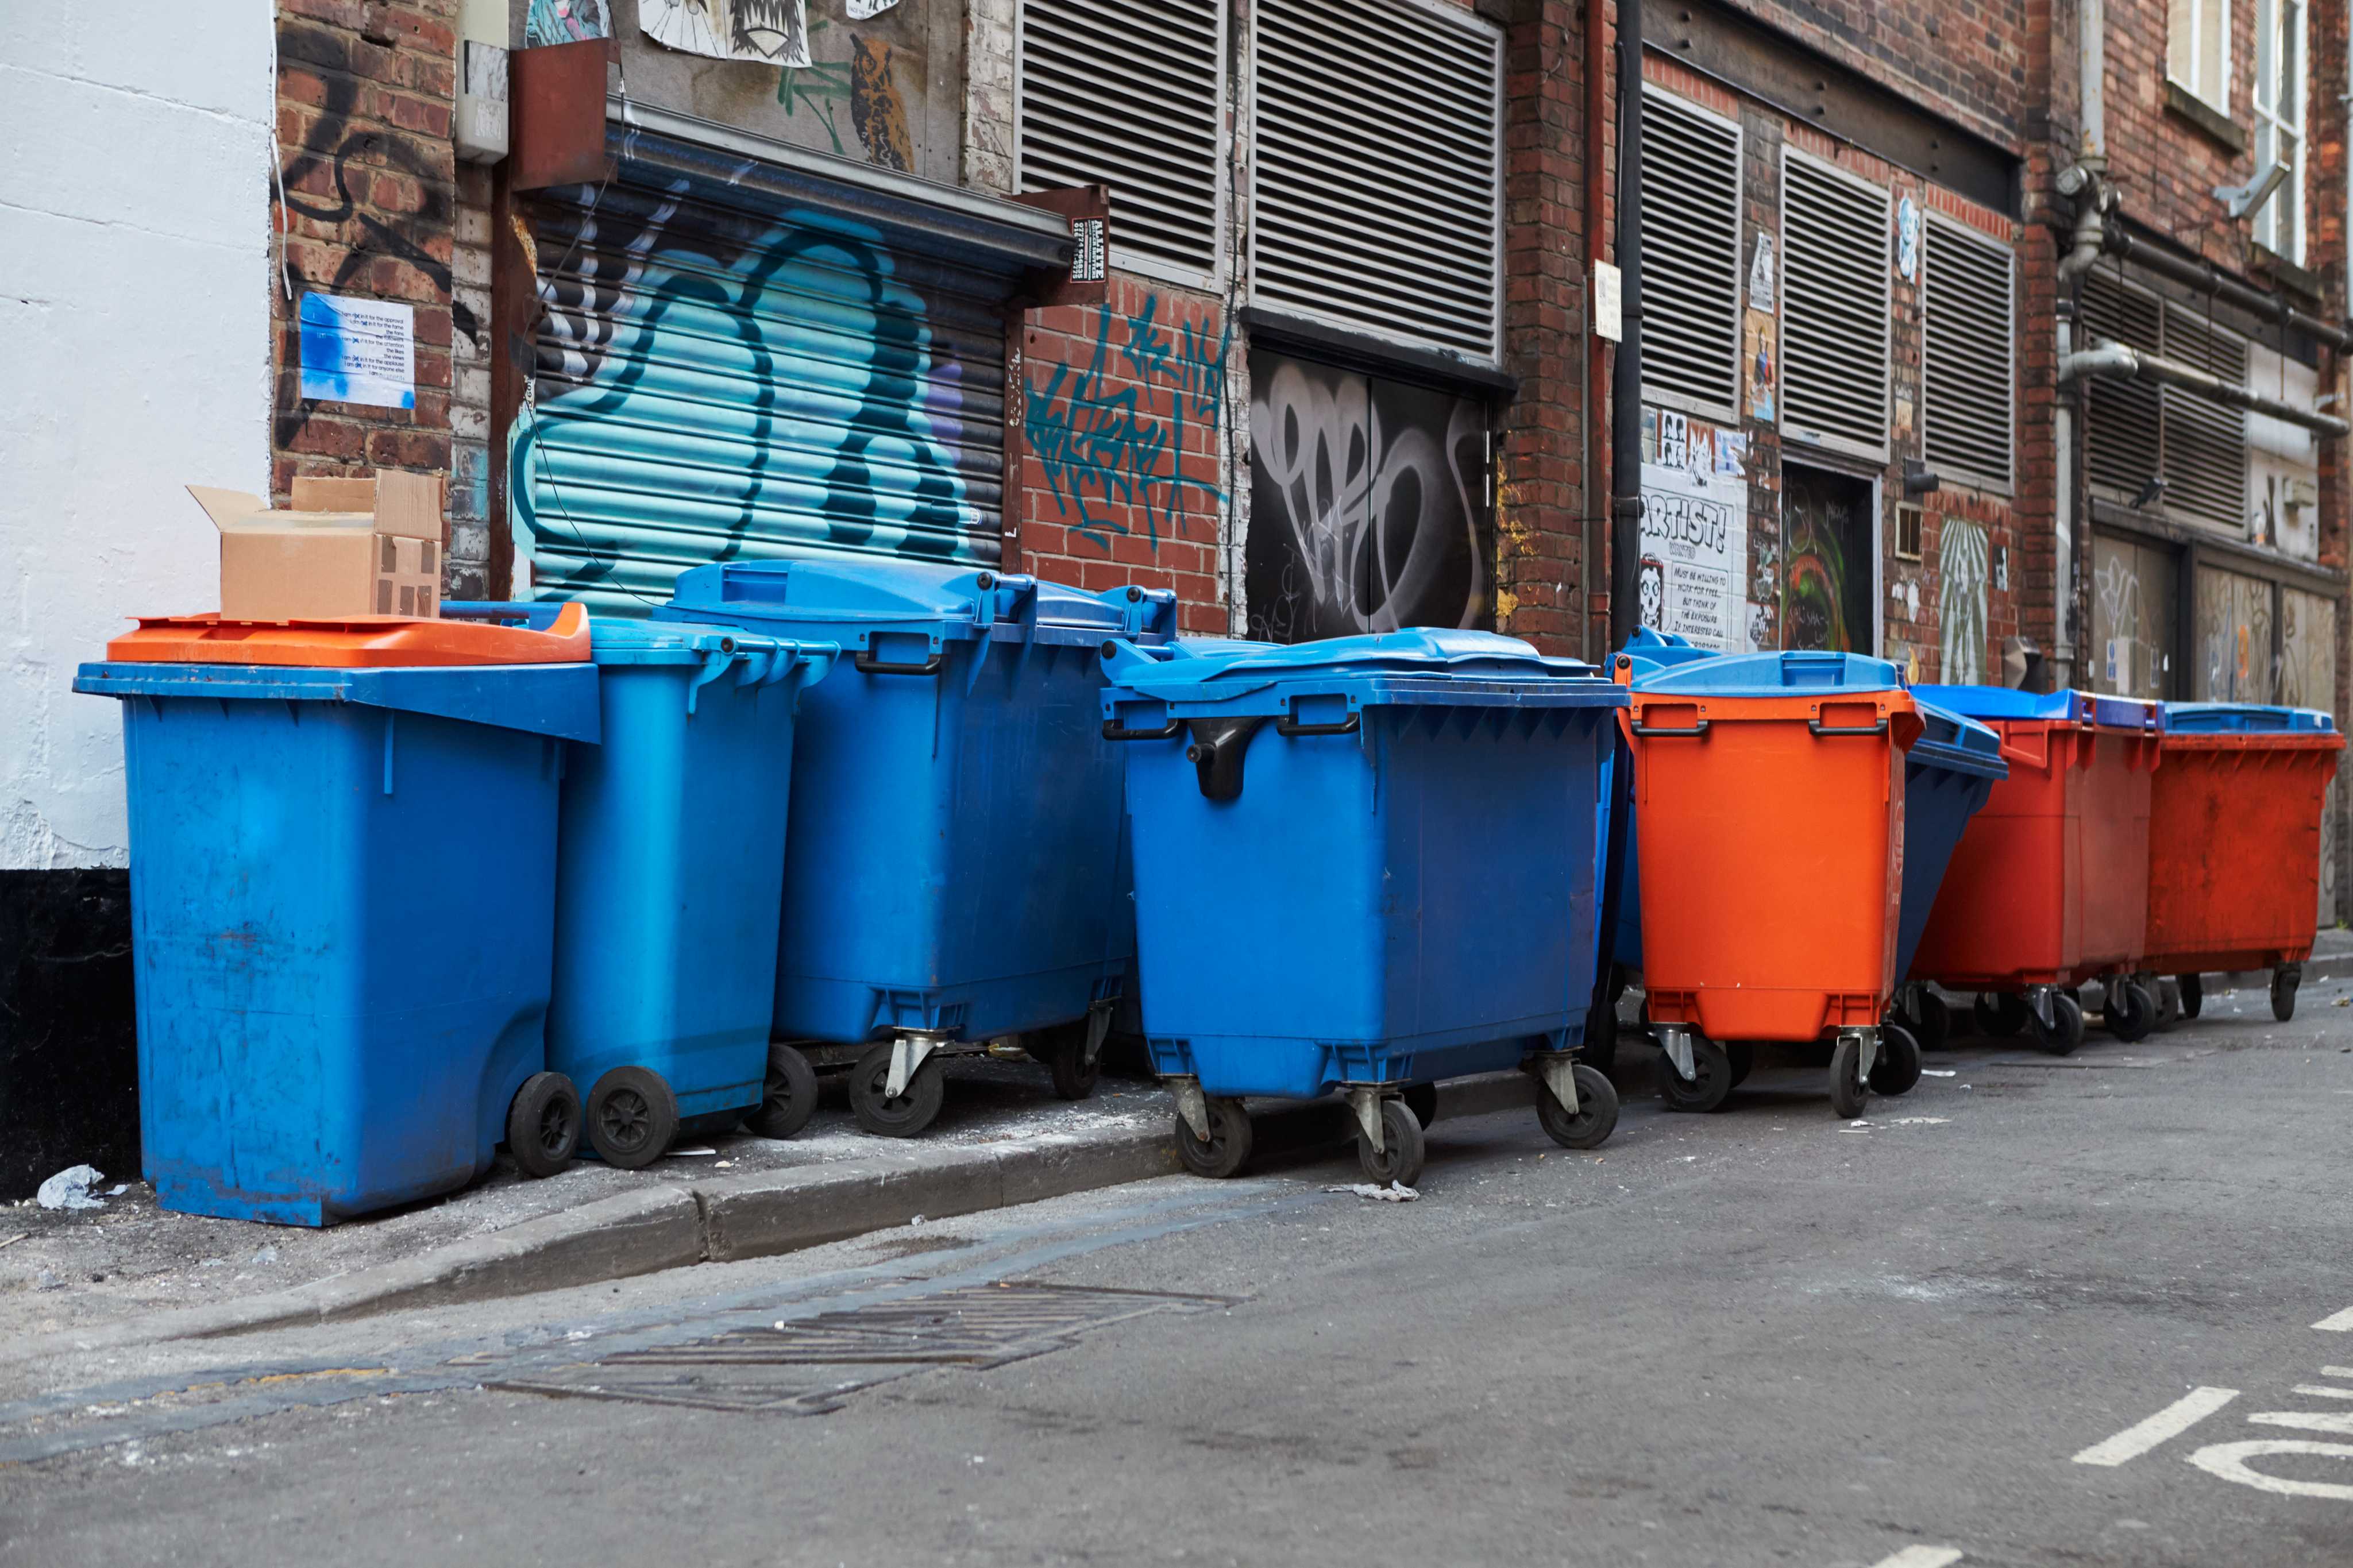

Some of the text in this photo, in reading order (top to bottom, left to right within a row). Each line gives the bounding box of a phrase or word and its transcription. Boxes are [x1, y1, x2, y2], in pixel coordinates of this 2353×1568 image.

[1094, 220, 1104, 279] ALLTITE
[1640, 495, 1727, 555] ARTIST!
[1674, 567, 1726, 586] MUST BE WILLING TO
[1677, 584, 1692, 592] WORK
[1694, 586, 1704, 594] FOR
[1683, 597, 1716, 611] BUT THINK OF
[1681, 611, 1718, 624] THE EXPOSURE
[1683, 623, 1712, 636] INTERESTED
[1712, 628, 1723, 638] CALL
